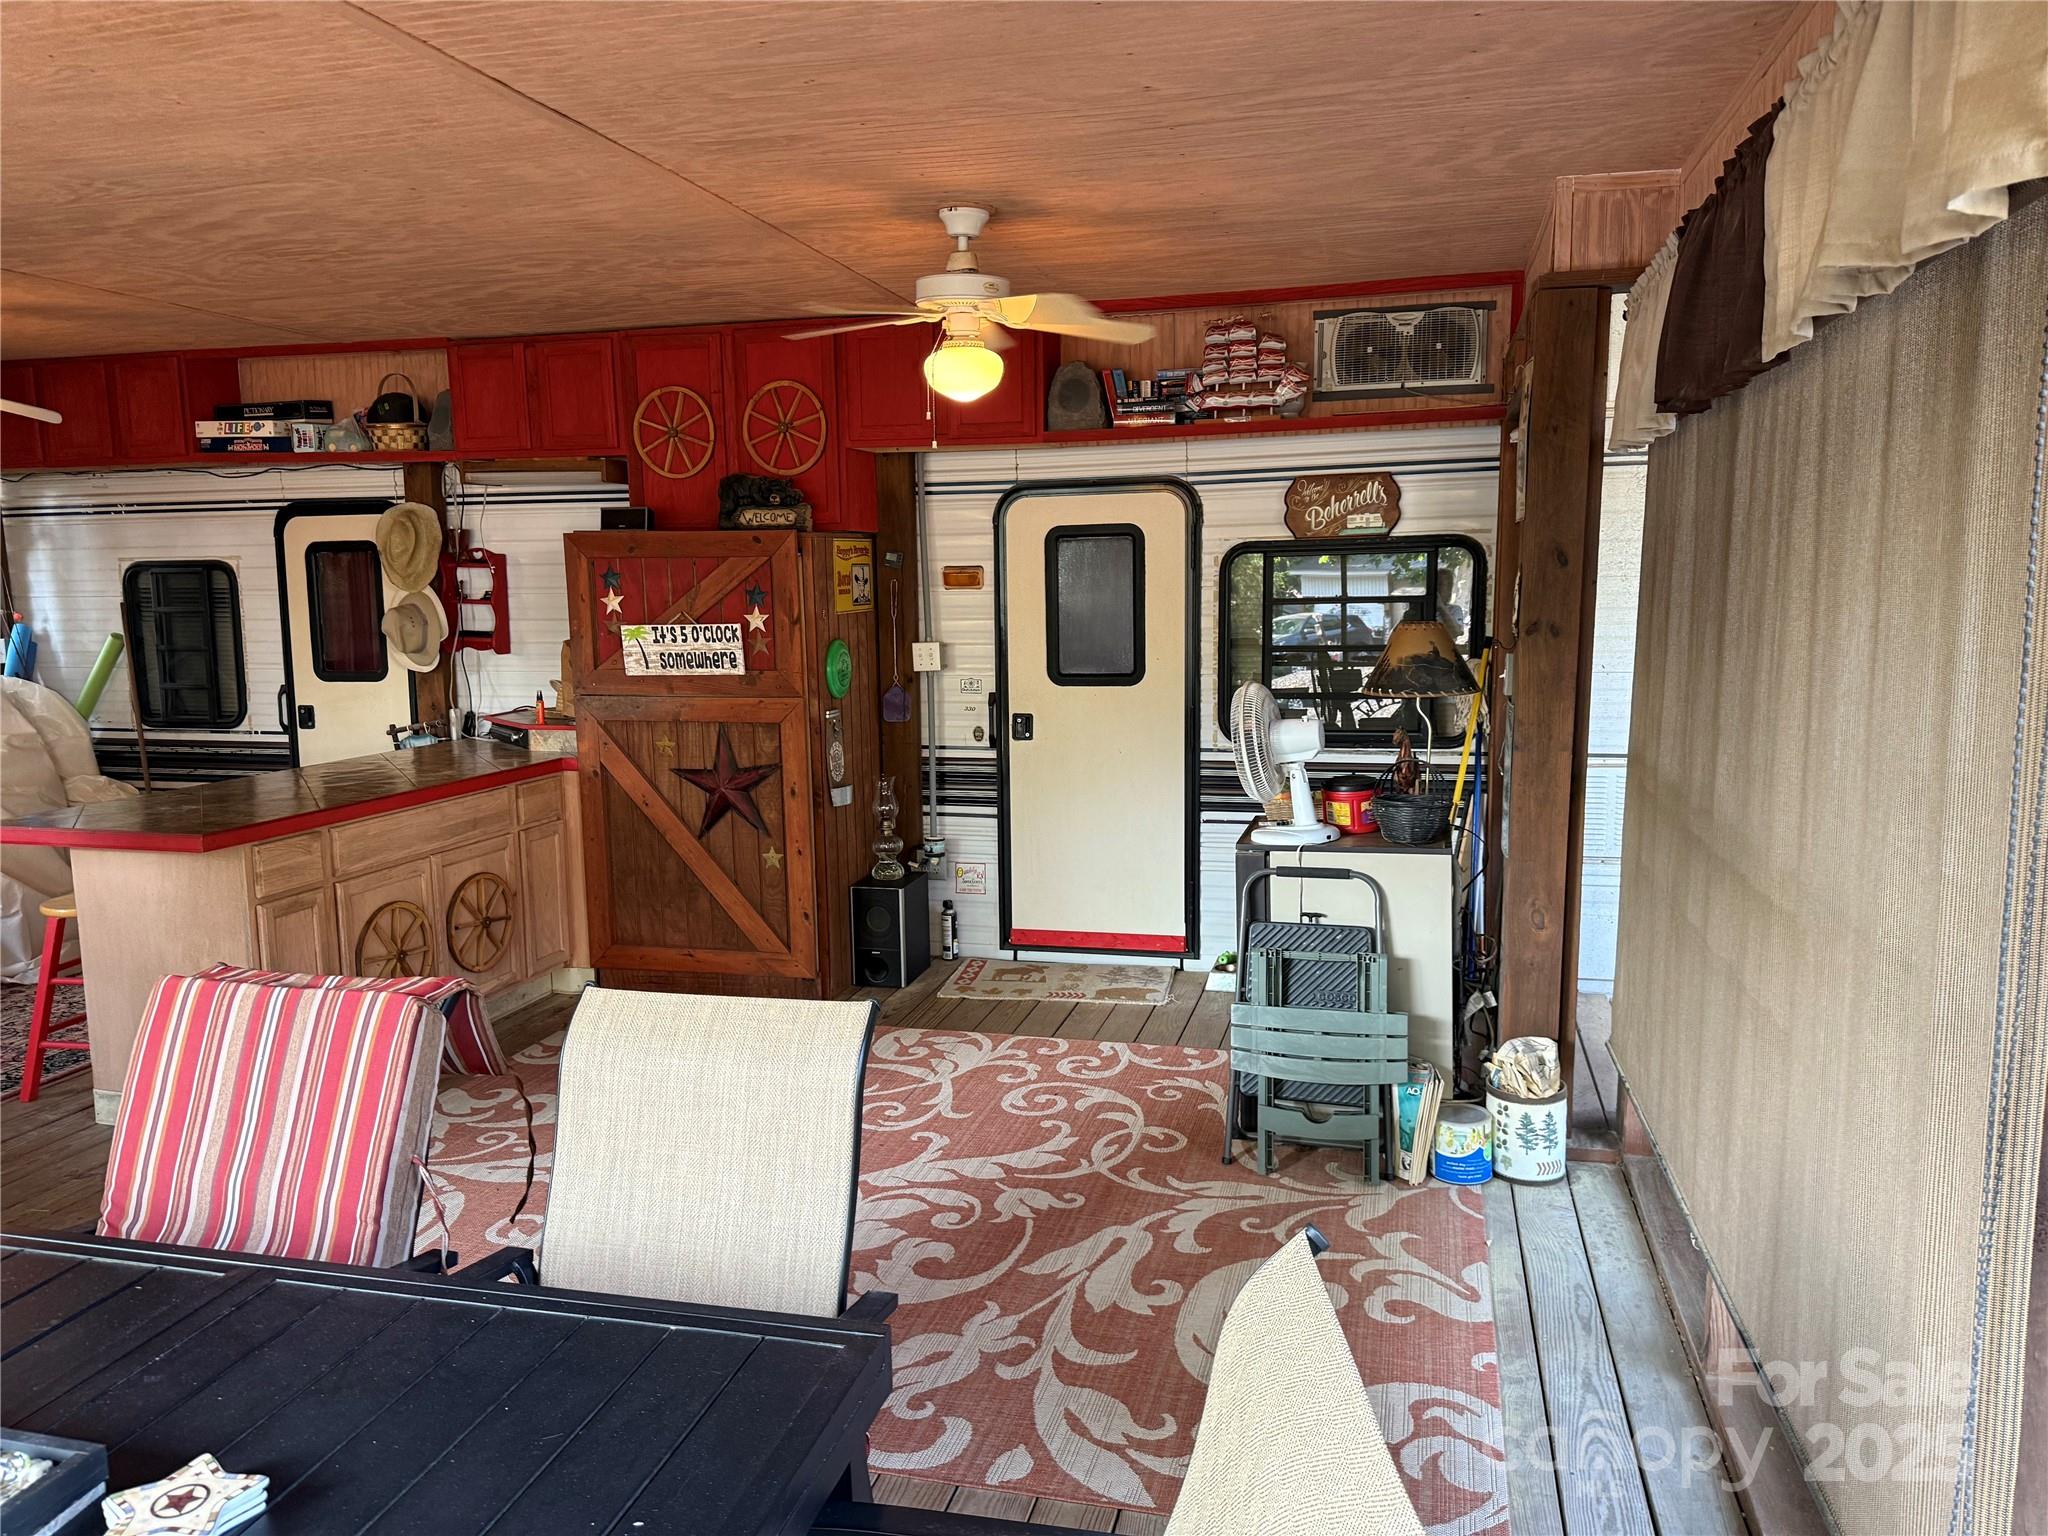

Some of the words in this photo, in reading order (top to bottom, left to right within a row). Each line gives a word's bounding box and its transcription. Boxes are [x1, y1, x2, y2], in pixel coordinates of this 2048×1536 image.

[224, 422, 251, 433] LIFE
[1305, 480, 1388, 531] Beherrell's
[742, 512, 793, 524] WELCOME
[680, 626, 688, 643] 5
[659, 651, 738, 669] somewhere
